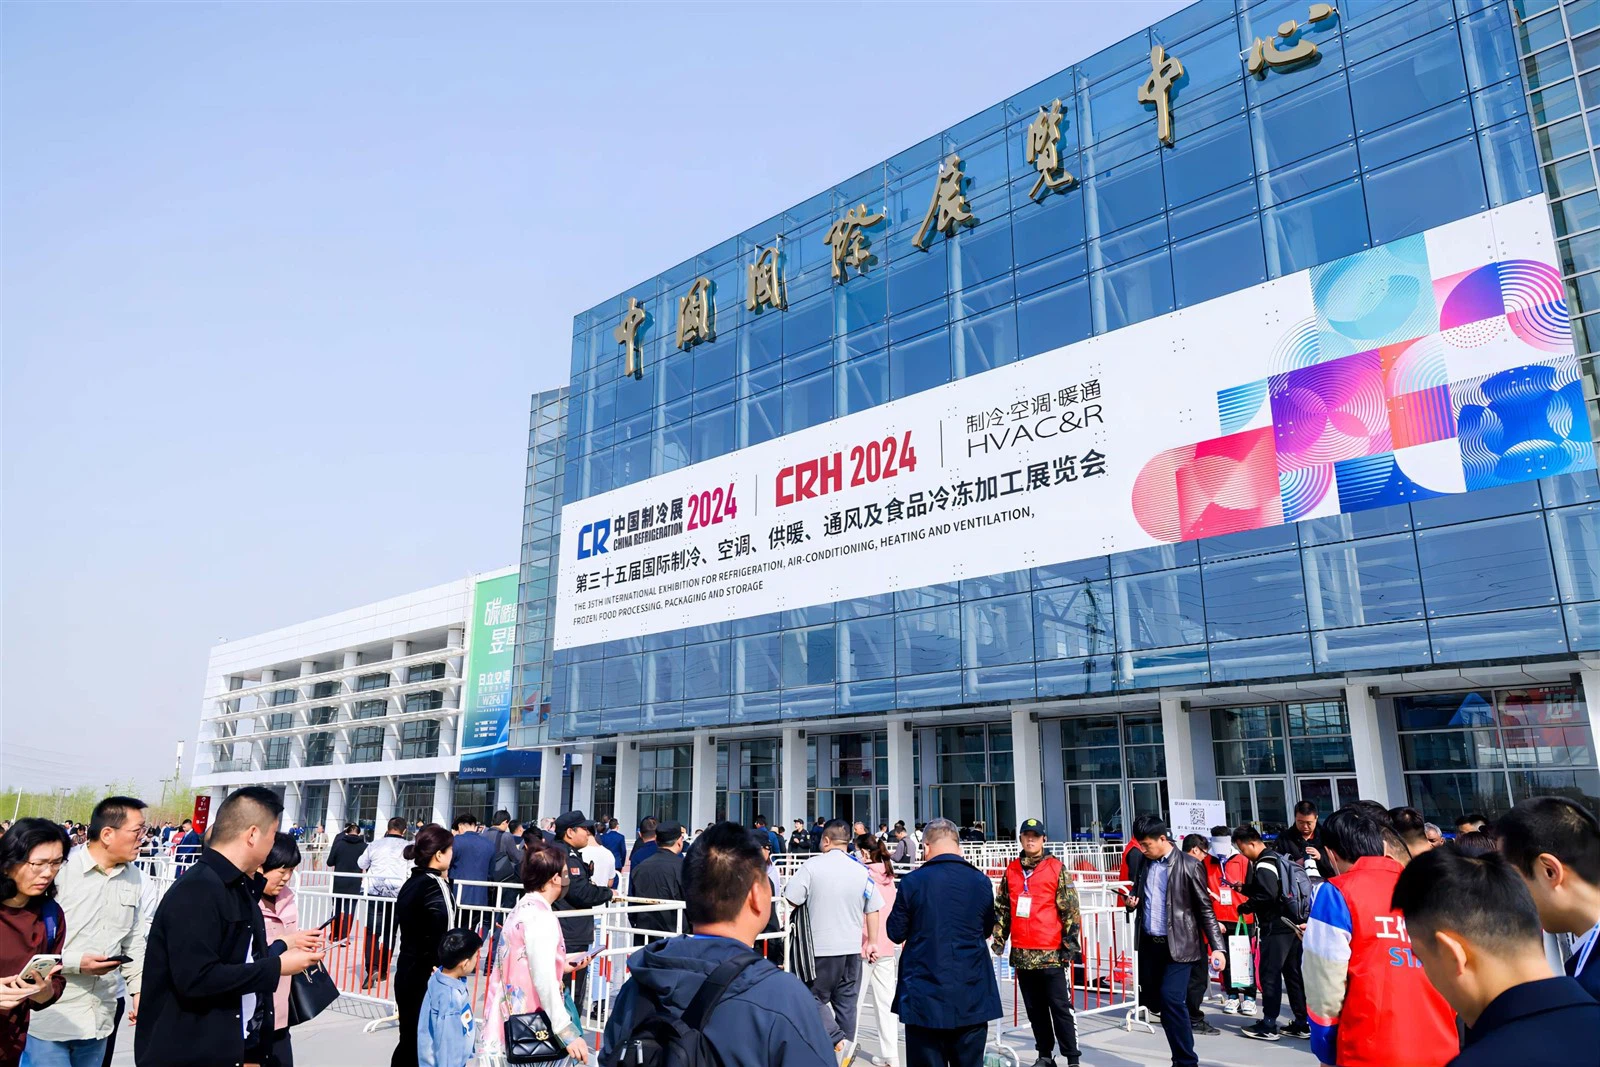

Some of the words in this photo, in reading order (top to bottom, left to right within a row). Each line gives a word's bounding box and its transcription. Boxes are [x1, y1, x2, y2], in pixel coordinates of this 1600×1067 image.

[966, 379, 1101, 434] 制冷·空调·暖通
[968, 404, 1104, 458] HVAC&R
[775, 452, 842, 507] CRH
[850, 430, 917, 488] 2024
[575, 448, 1107, 594] 第三十五届国际制冷、空调、供暖、通风及食品冷冻加工展览会
[613, 497, 684, 537] 中国制冷展
[687, 483, 738, 531] 2024
[574, 602, 587, 612] THE
[604, 588, 658, 608] INTERNATIONAL
[658, 578, 701, 596] EXHIBITION
[701, 573, 718, 587] FOR
[718, 557, 786, 582] REFRIGERATION,
[787, 538, 879, 567] AIR-CONDITIONING,
[880, 527, 927, 548] HEATING
[928, 522, 952, 538] AND
[952, 505, 1037, 534] VENTILATION,
[577, 518, 611, 560] CR
[613, 537, 633, 551] CHINA
[633, 521, 683, 546] REFRIGERATION
[573, 615, 598, 626] FROZEN
[598, 610, 617, 623] FOOD
[664, 592, 708, 609] PACKAGING
[708, 588, 725, 602] AND
[726, 580, 764, 597] STORAGE
[1388, 946, 1423, 968] ST
